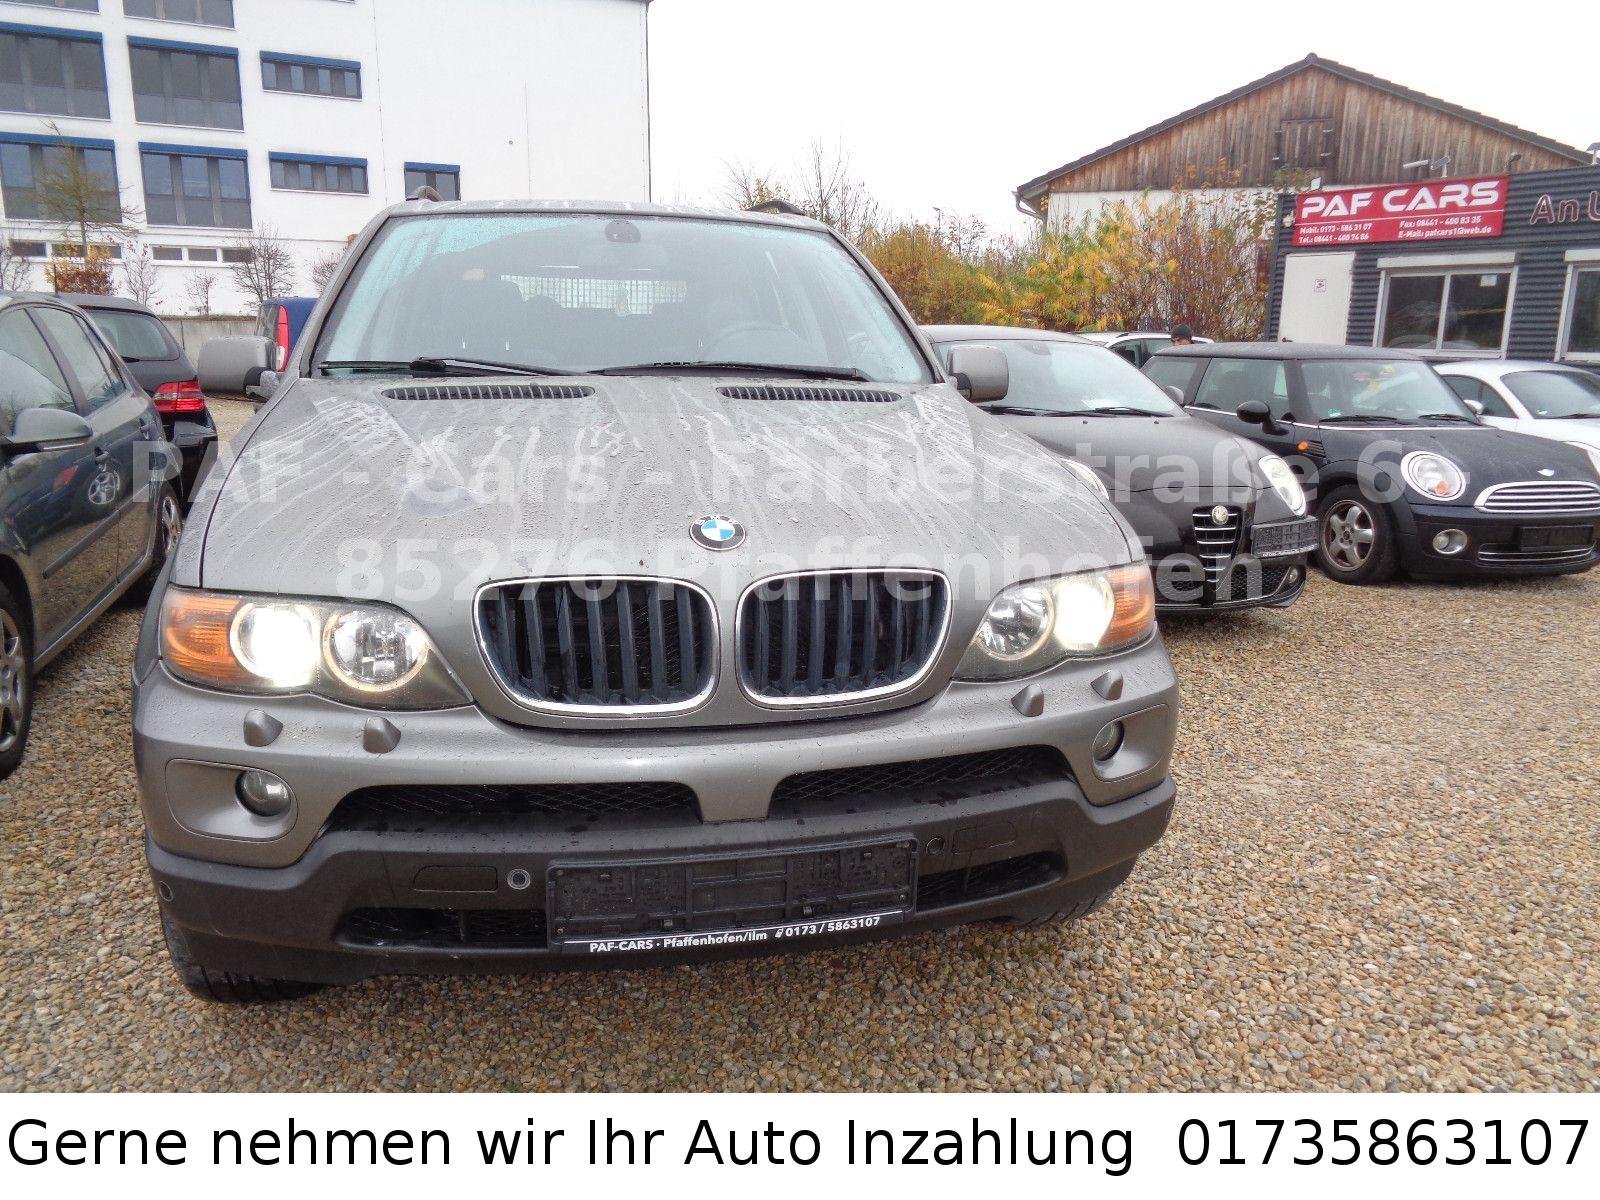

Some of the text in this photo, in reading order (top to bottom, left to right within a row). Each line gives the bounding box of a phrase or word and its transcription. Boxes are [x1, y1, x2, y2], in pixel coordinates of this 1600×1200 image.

[1301, 180, 1500, 219] PAF CARS
[1529, 194, 1580, 225] An
[1300, 226, 1320, 234] Mobil:
[1320, 224, 1336, 233] 0173
[1398, 229, 1424, 238] E-Mail:
[1399, 220, 1415, 228] Fax:
[589, 940, 653, 953] PAF-CARS
[663, 930, 767, 948] Pfaffenhofen/Ilm
[785, 924, 817, 937] 0173
[827, 916, 881, 932] 5863107
